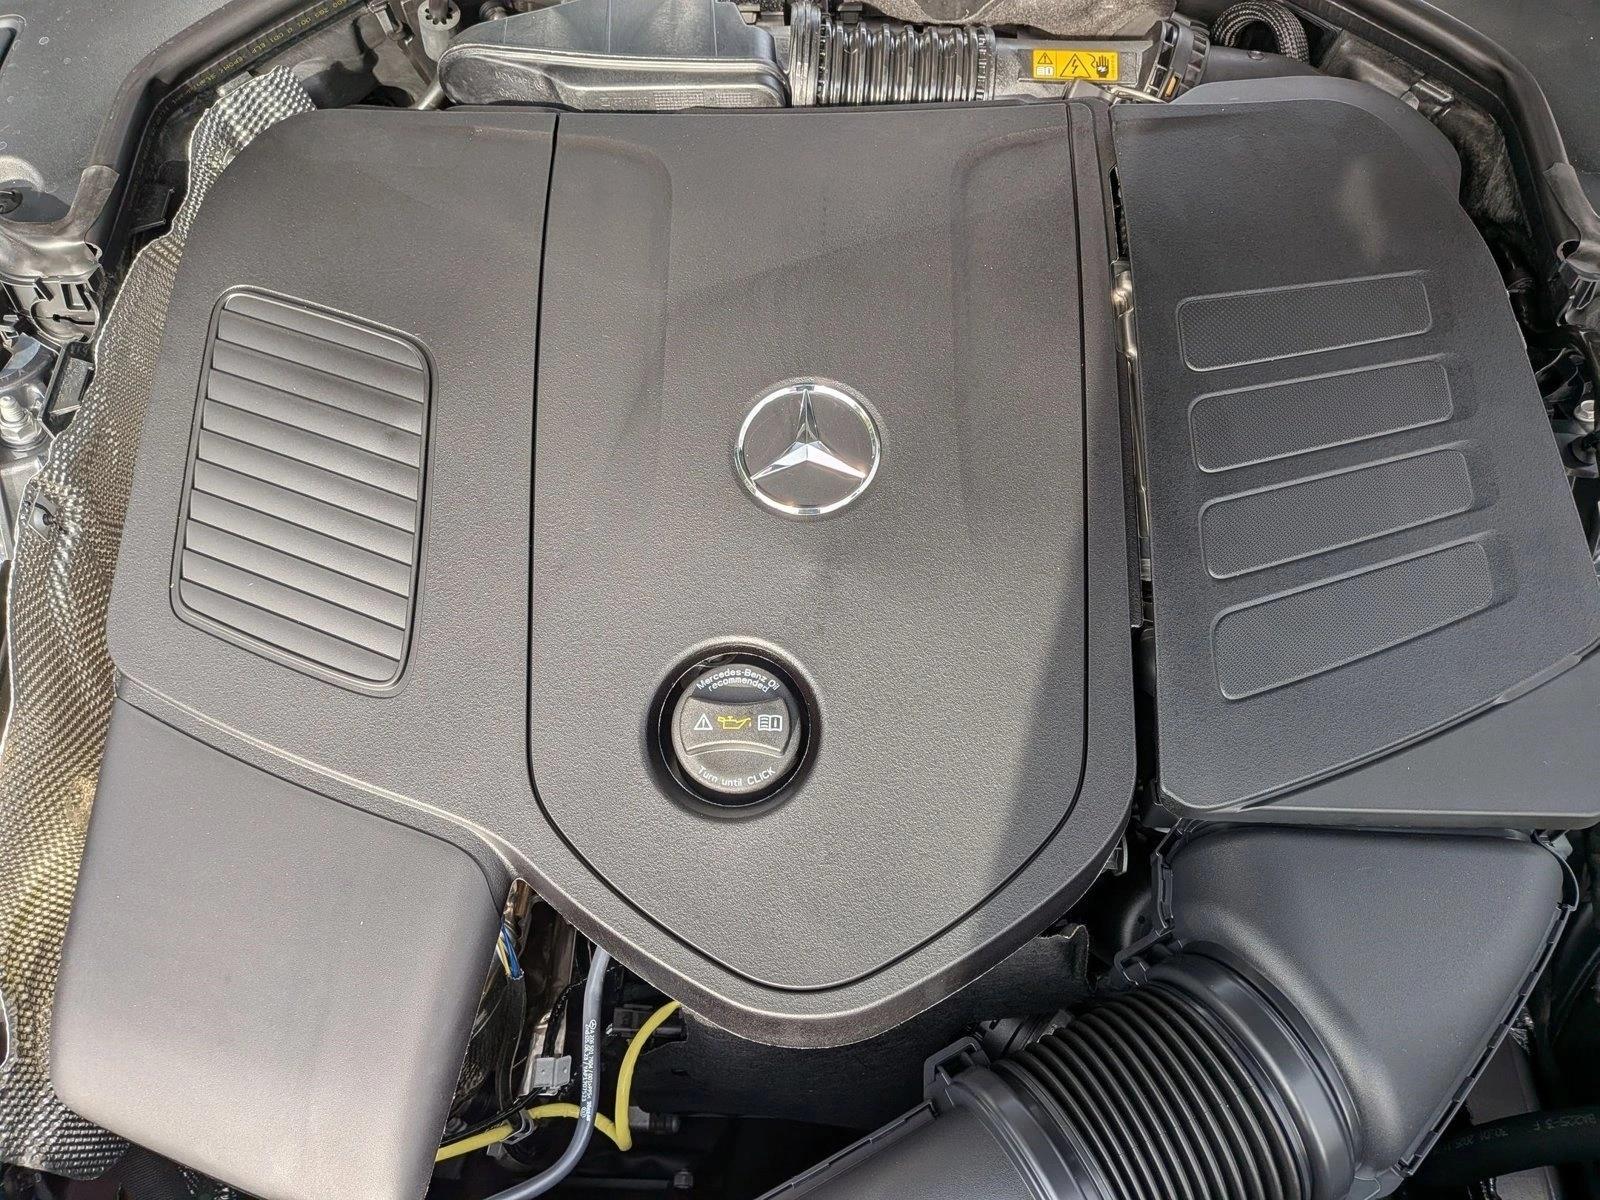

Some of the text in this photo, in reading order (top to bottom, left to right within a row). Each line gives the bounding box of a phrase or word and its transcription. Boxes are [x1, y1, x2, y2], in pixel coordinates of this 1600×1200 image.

[696, 668, 780, 691] Mercedes-Benz Oil
[708, 677, 770, 693] recommended
[698, 765, 776, 787] Turn until CLICK
